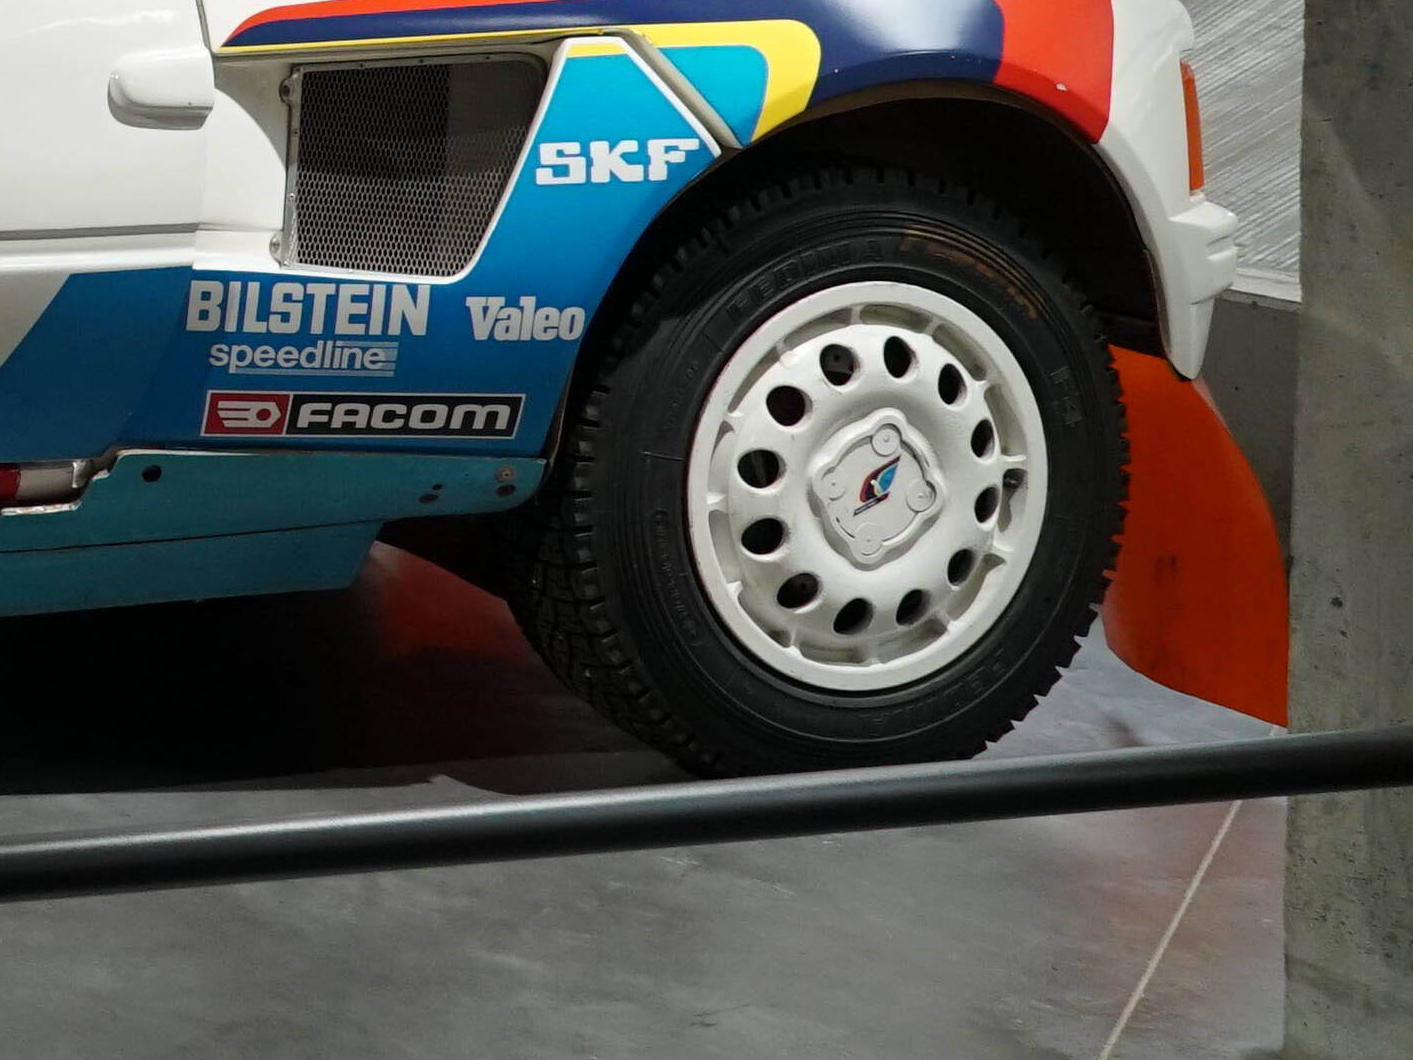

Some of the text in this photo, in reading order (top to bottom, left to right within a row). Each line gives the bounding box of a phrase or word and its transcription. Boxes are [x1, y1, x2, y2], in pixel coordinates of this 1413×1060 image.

[535, 138, 699, 184] SKF
[186, 280, 430, 336] BILSTEIN
[466, 296, 585, 341] Valeo
[209, 340, 388, 374] speedline
[297, 402, 512, 430] FACOM
